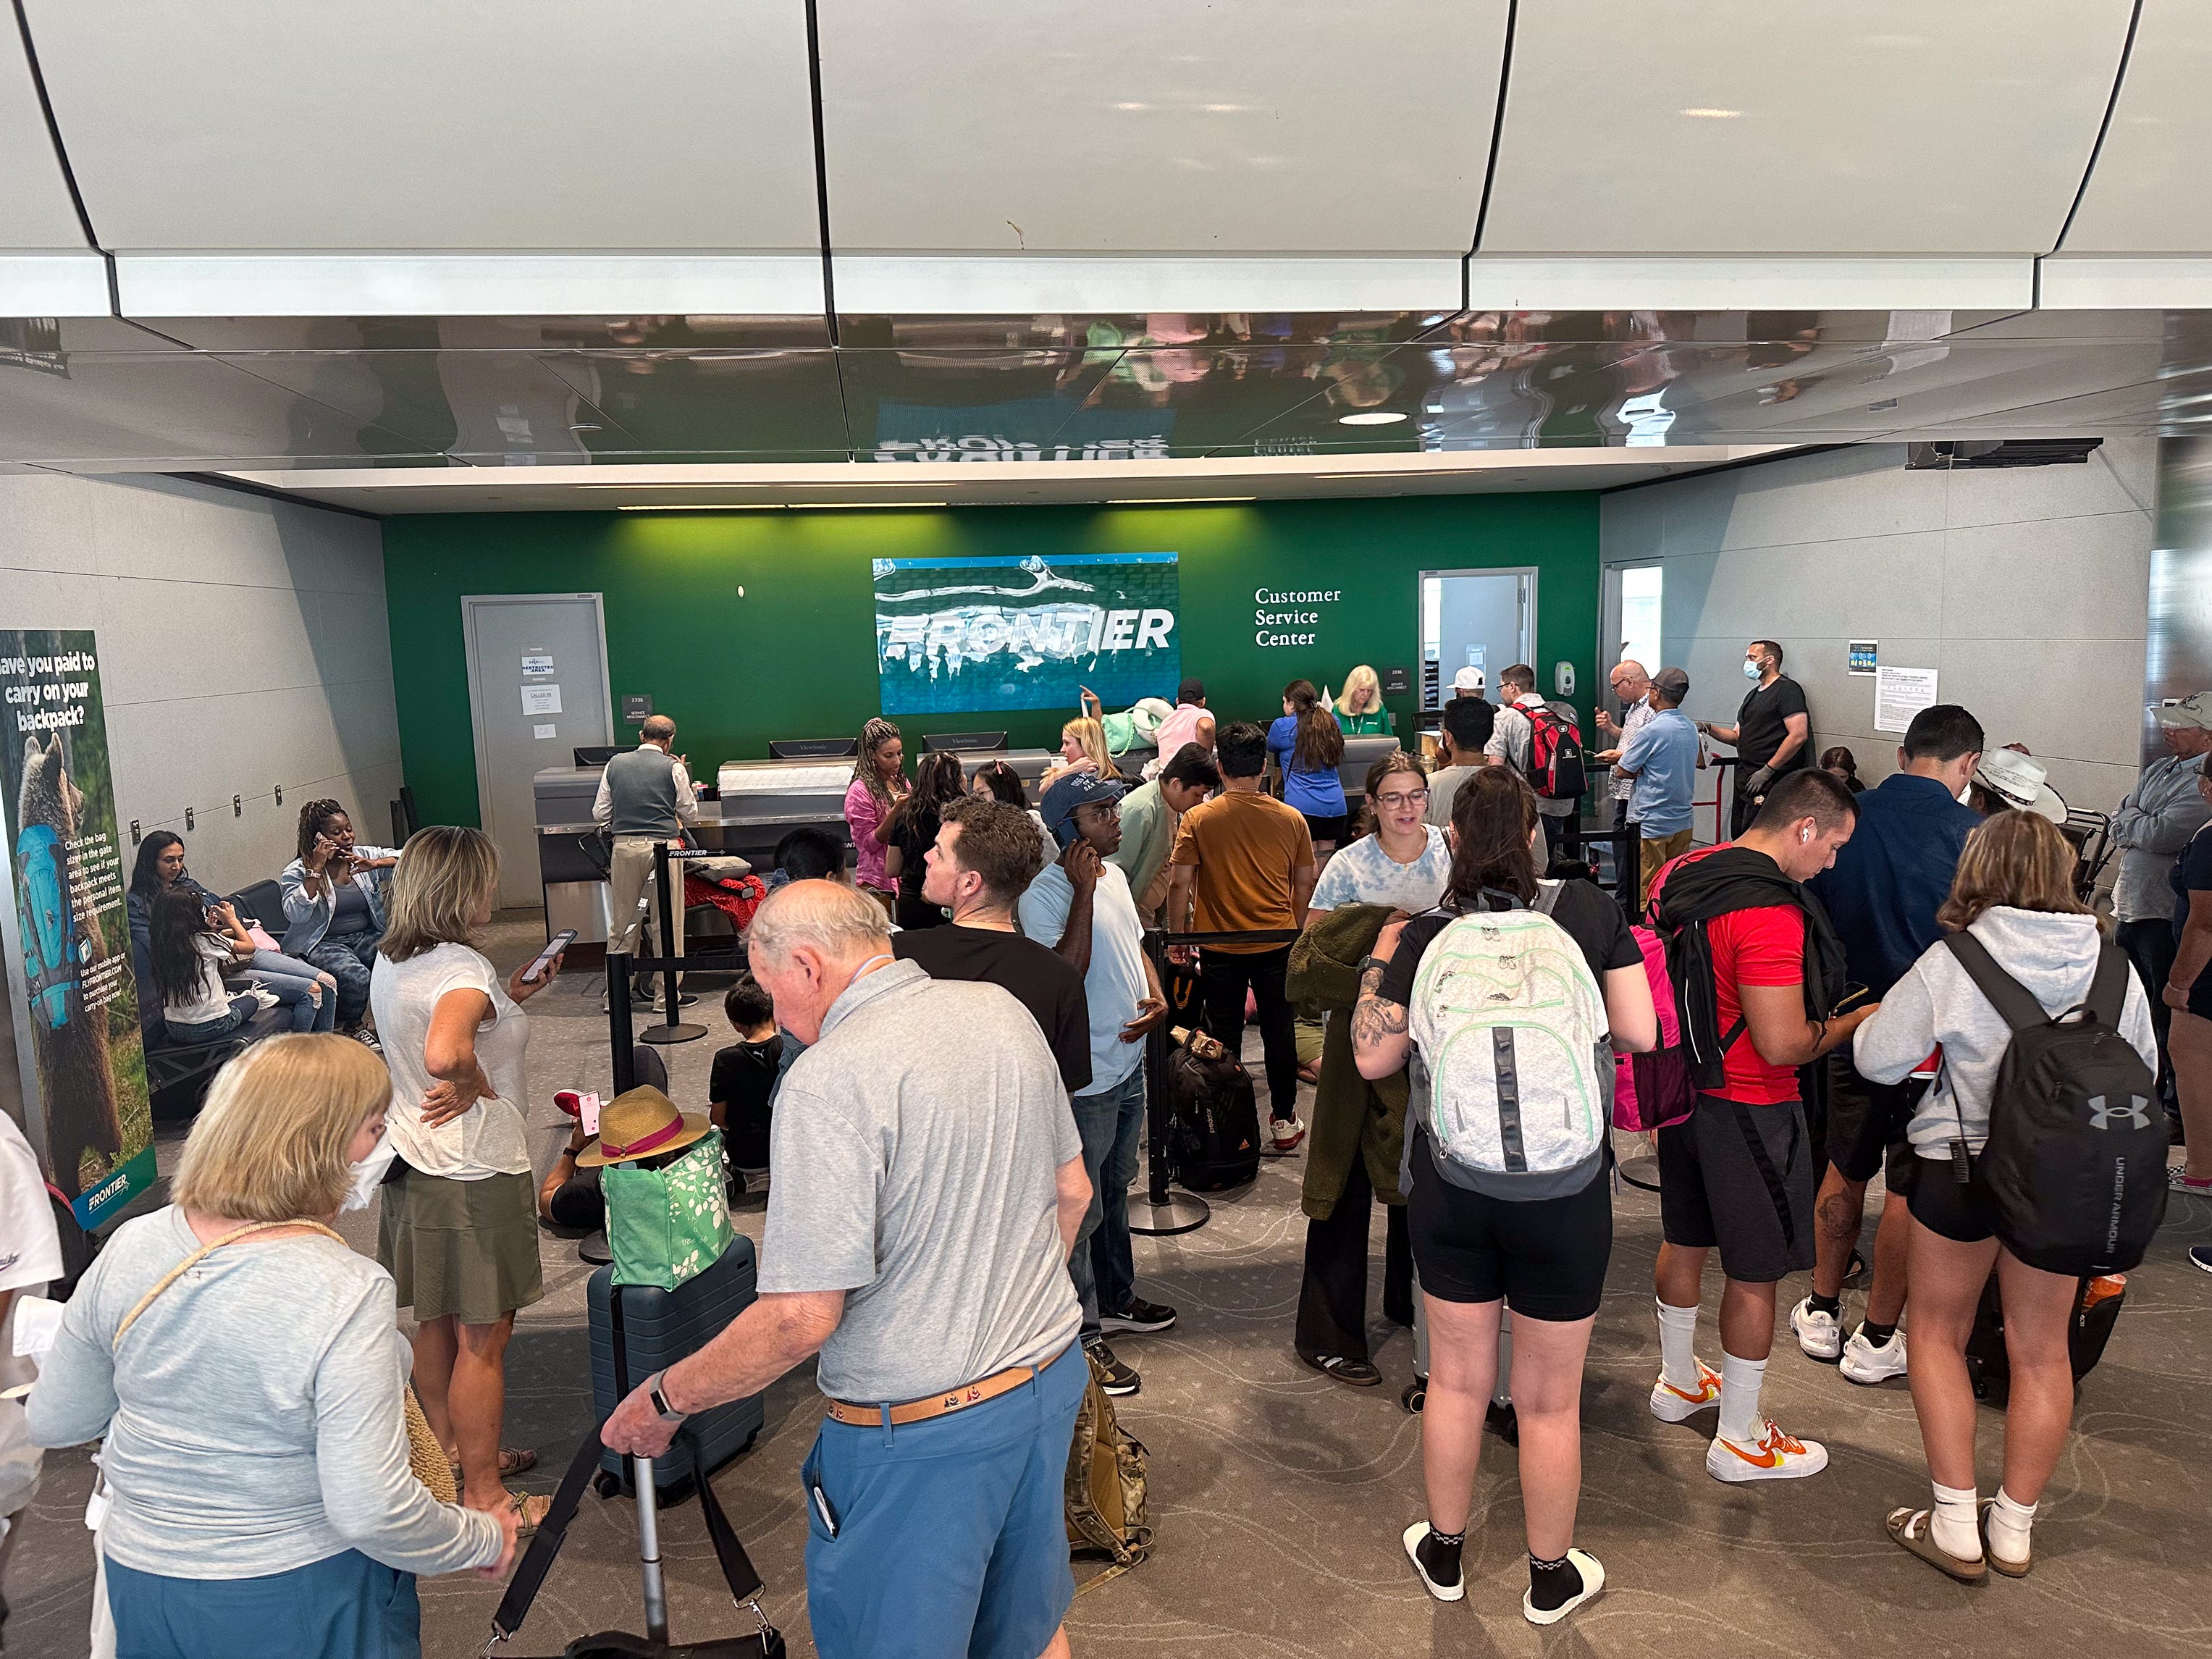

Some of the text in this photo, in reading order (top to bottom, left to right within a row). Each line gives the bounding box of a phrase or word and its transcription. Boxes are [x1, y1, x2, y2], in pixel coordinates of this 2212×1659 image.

[1255, 588, 1342, 604] Customer
[1255, 609, 1319, 626] Service
[885, 608, 1175, 657] FRONTIER
[1256, 630, 1316, 647] Center
[0, 651, 95, 677] ave you paid to
[5, 682, 89, 706] carry on your
[17, 705, 85, 732] backpack?
[1083, 782, 1096, 791] SAN
[64, 833, 106, 851] Check the bag
[67, 844, 112, 865] sizer in the gate
[68, 857, 119, 880] area to see if your
[70, 871, 117, 894] backpack meets
[71, 884, 122, 908] the personal item
[73, 897, 122, 923] size requirement.
[80, 969, 90, 978] Use
[98, 957, 112, 970] mobile
[82, 965, 122, 989] FLYFRONTIER.COM
[89, 984, 108, 999] purchase
[109, 979, 118, 990] your
[85, 999, 104, 1012] carry-on
[103, 994, 112, 1003] bag
[1206, 1108, 1216, 1134] predator
[2114, 1156, 2126, 1201] UNDER
[88, 1174, 127, 1211] FRONTIER
[2106, 1202, 2122, 1253] ARMOUR
